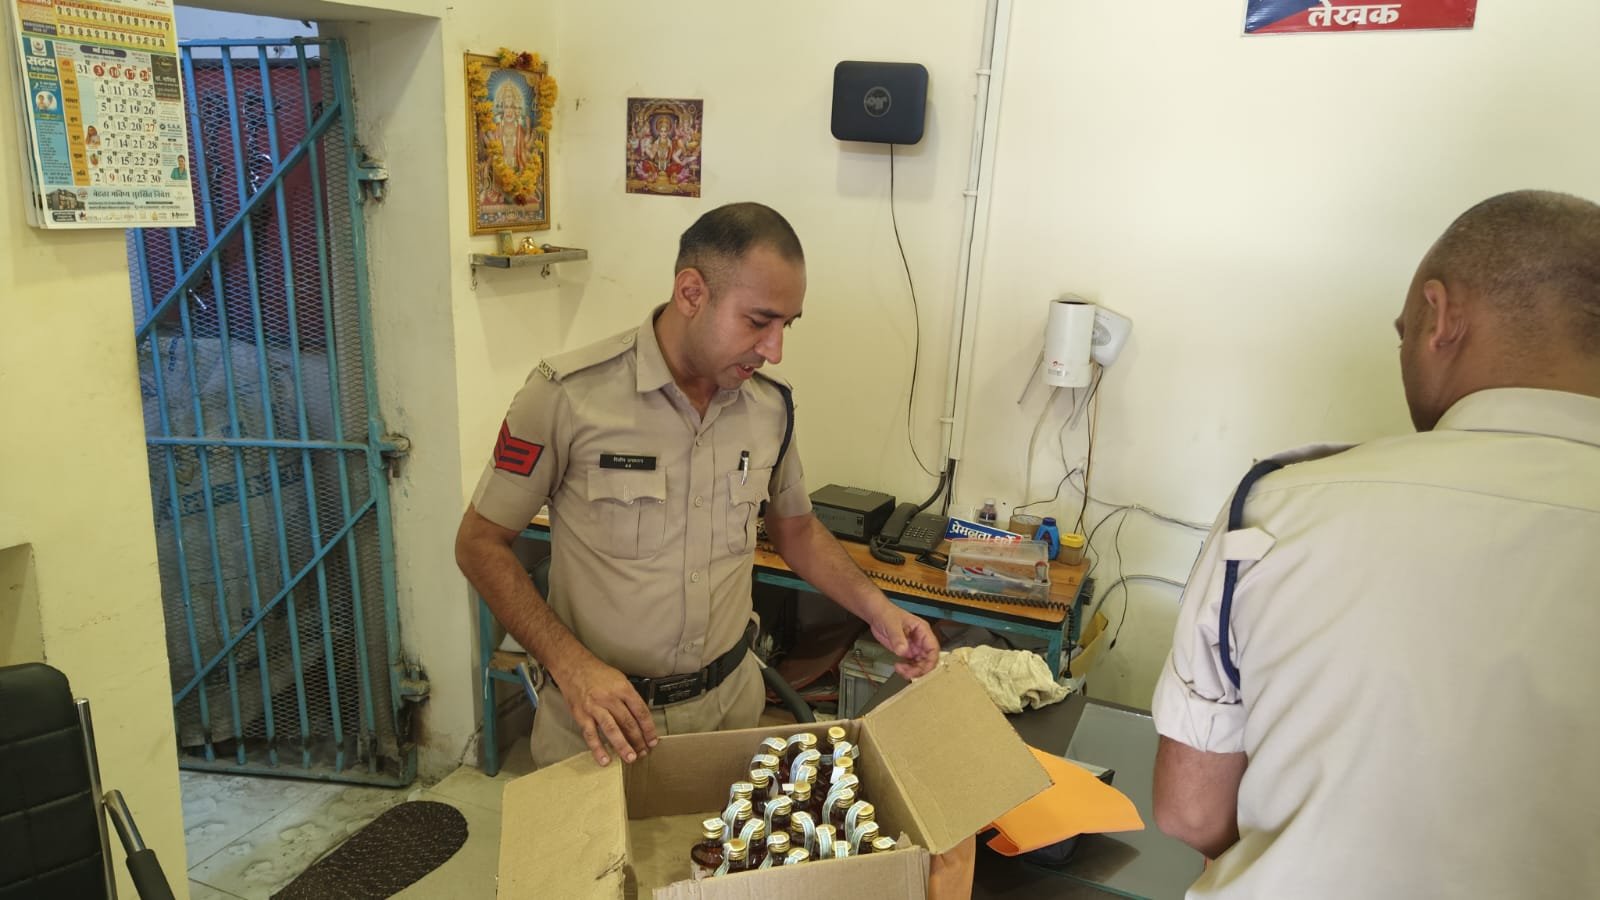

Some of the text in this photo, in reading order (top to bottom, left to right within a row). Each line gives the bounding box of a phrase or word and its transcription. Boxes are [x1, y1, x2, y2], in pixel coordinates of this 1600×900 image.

[1308, 0, 1402, 26] लेखक
[77, 64, 88, 74] 31
[100, 84, 105, 94] 4
[113, 86, 122, 95] 11
[127, 87, 138, 97] 18
[142, 89, 153, 98] 25
[101, 102, 107, 112] 5
[115, 104, 125, 113] 12
[129, 105, 140, 114] 19
[143, 106, 154, 115] 26
[103, 121, 155, 133] 6 13 20 27
[105, 138, 110, 147] 7
[119, 139, 128, 148] 14
[133, 140, 143, 149] 21
[147, 141, 158, 149] 28
[107, 156, 113, 165] 8
[121, 156, 130, 166] 15
[134, 157, 146, 166] 22
[149, 157, 159, 166] 29
[94, 173, 161, 183] 2 9 16 23 30
[950, 520, 992, 544] प्रेमलता
